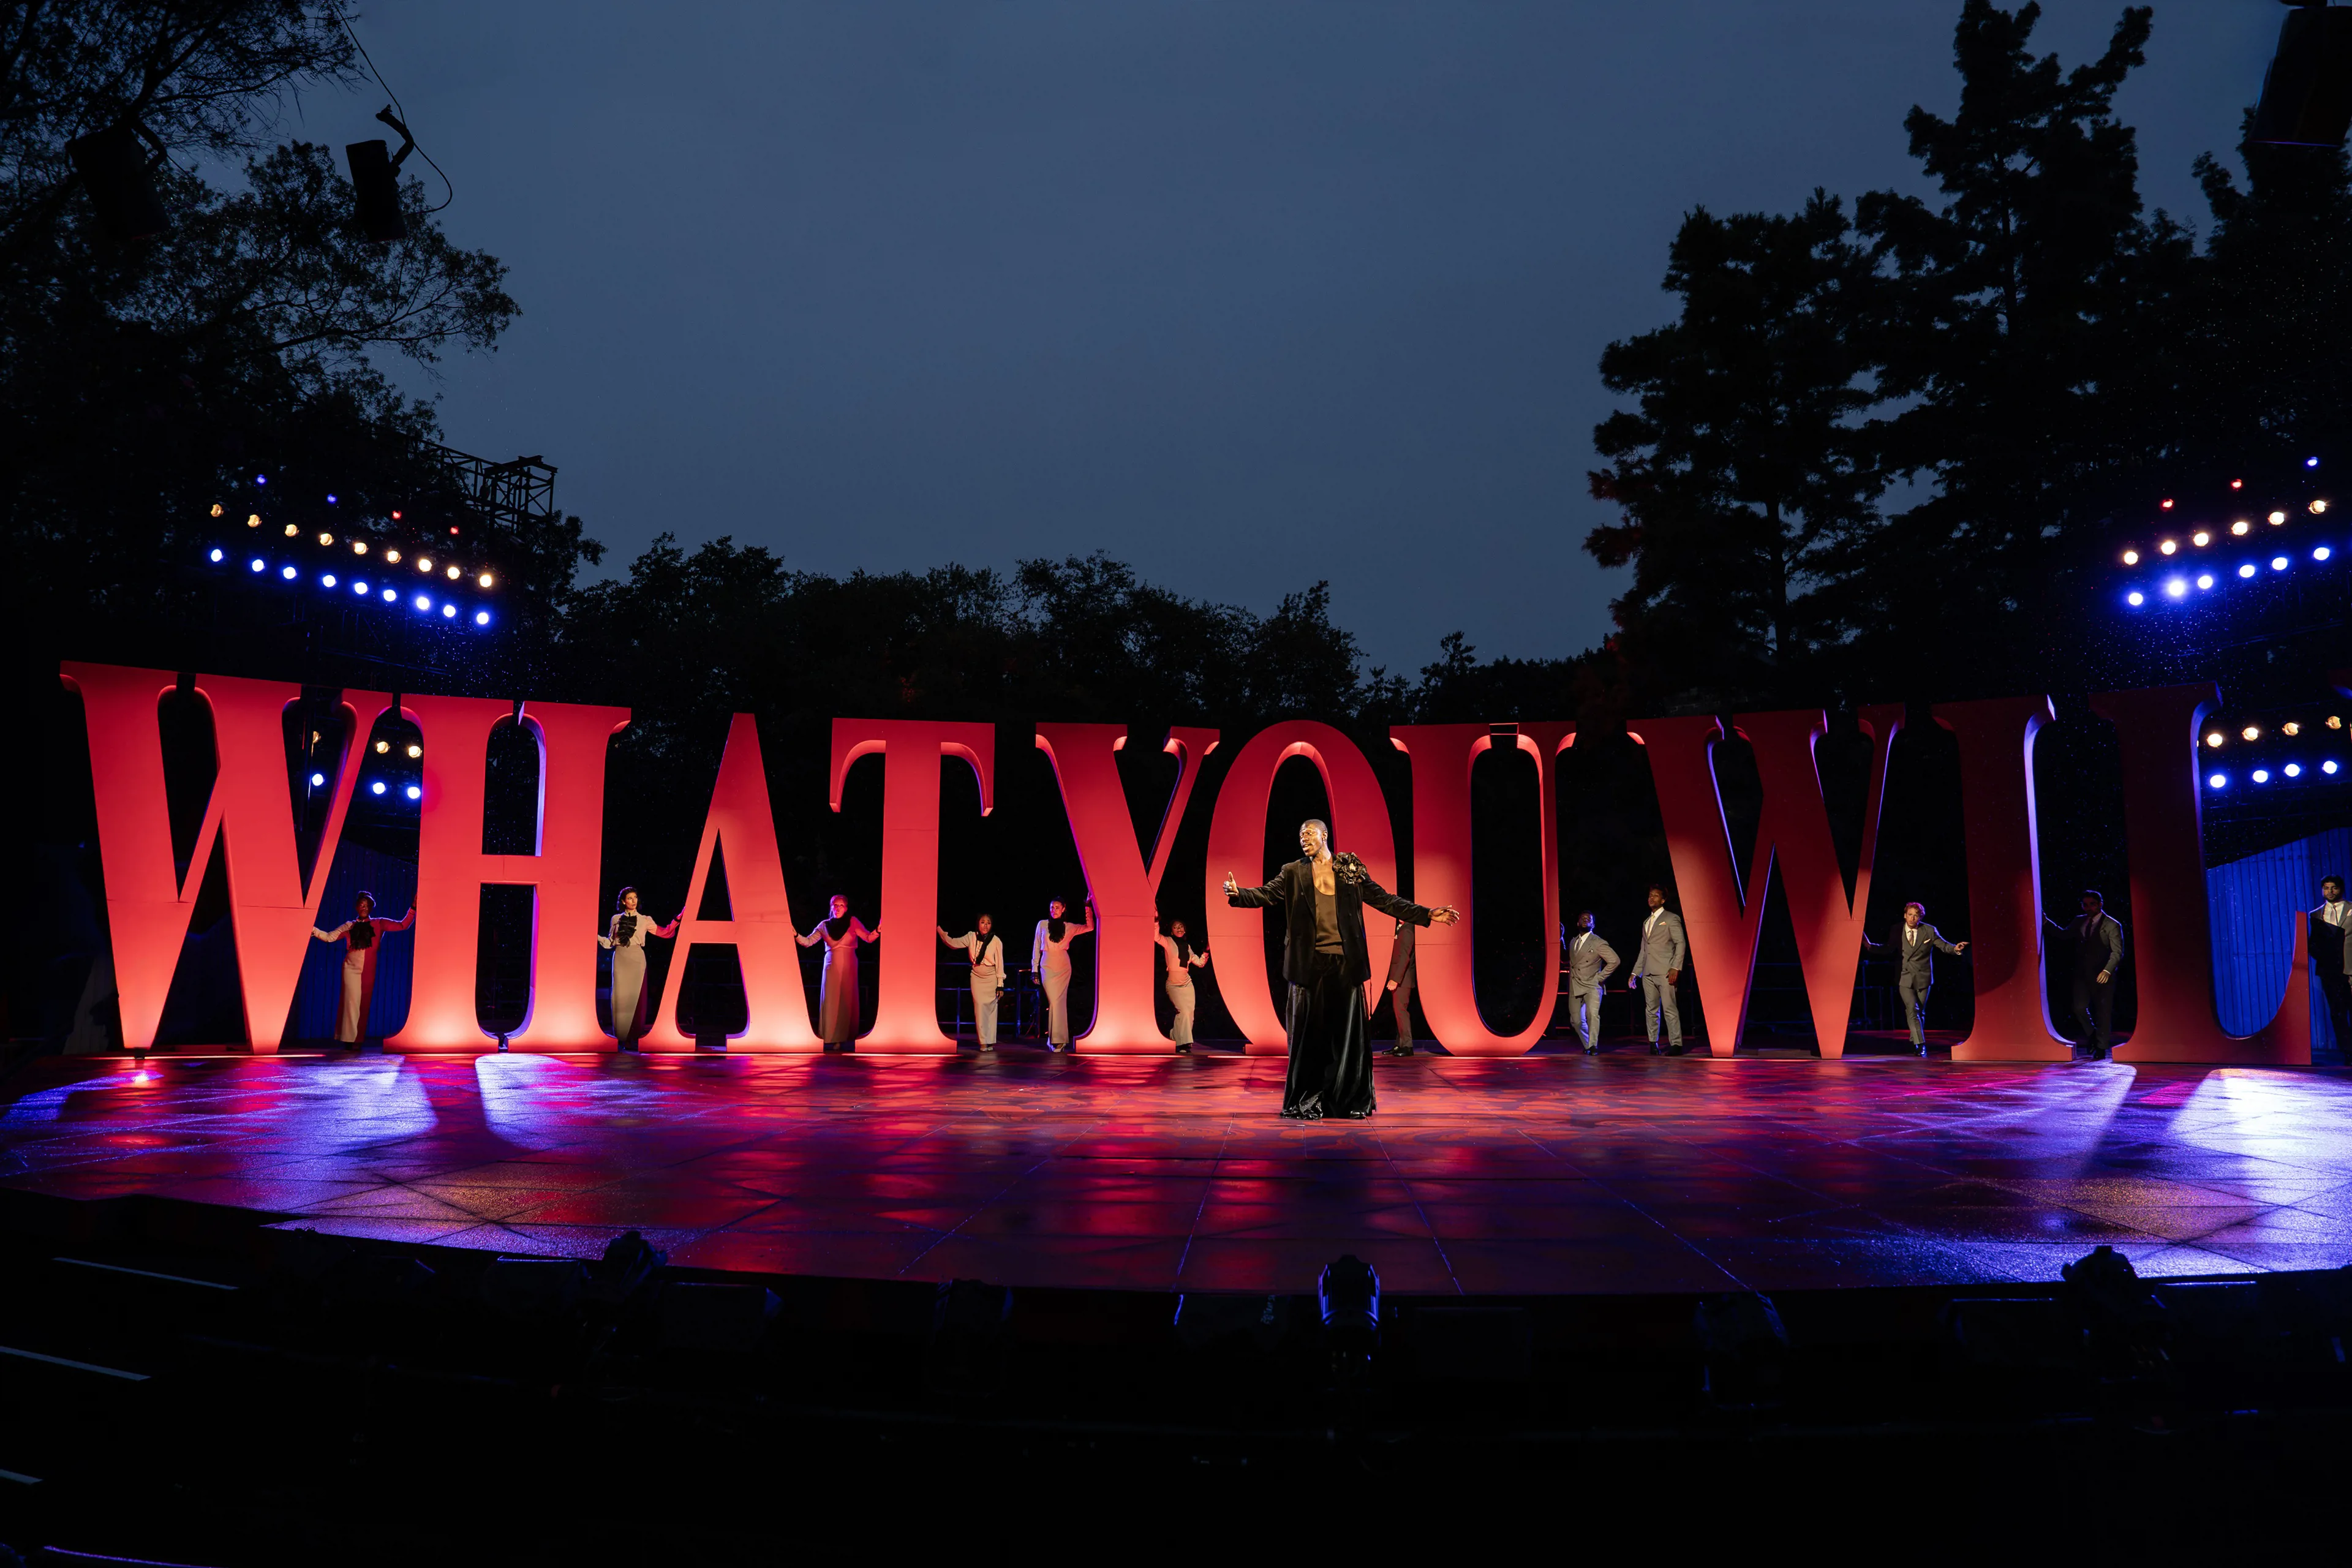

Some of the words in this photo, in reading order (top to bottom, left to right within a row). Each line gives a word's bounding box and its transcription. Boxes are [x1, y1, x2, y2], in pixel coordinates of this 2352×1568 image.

[59, 660, 995, 1054] WHAT
[1035, 720, 1577, 1056] YOU
[1626, 668, 2352, 1066] WIL
